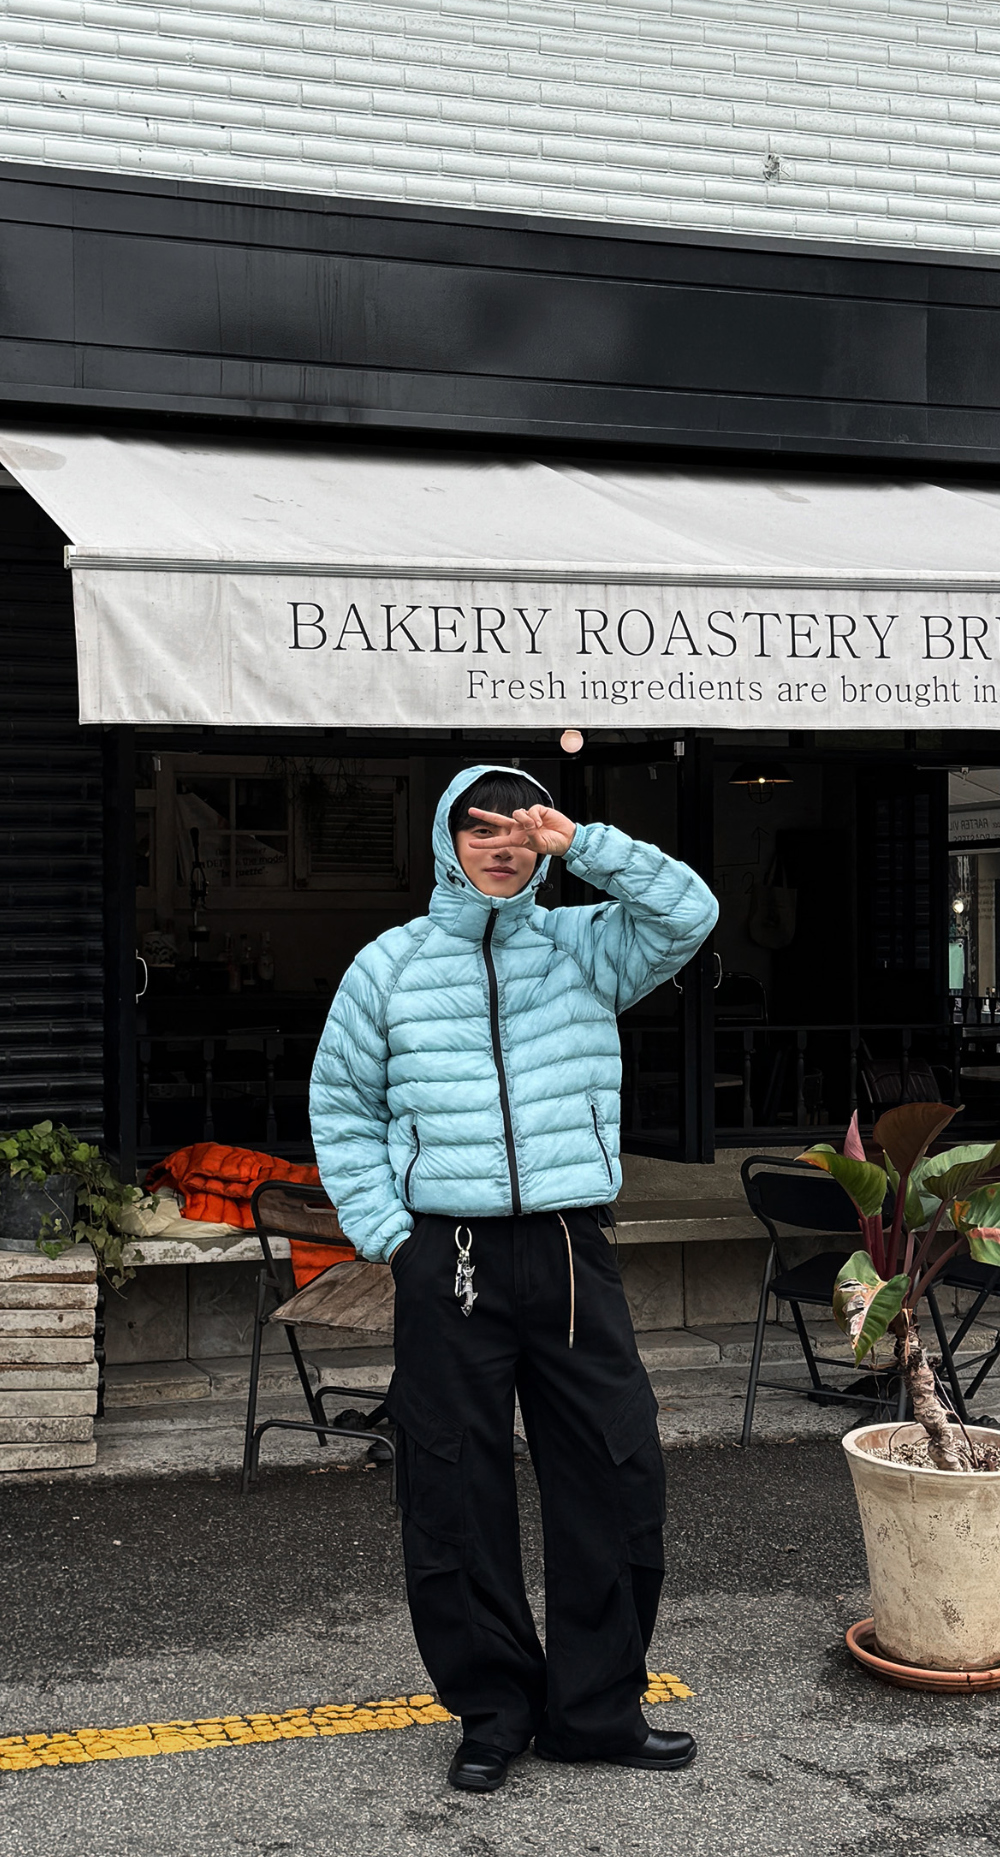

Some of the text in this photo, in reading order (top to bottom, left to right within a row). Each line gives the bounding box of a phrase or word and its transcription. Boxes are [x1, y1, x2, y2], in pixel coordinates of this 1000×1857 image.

[287, 602, 1000, 661] BAKERY ROASTERY BR
[466, 669, 998, 708] Fresh ingredients are brought in
